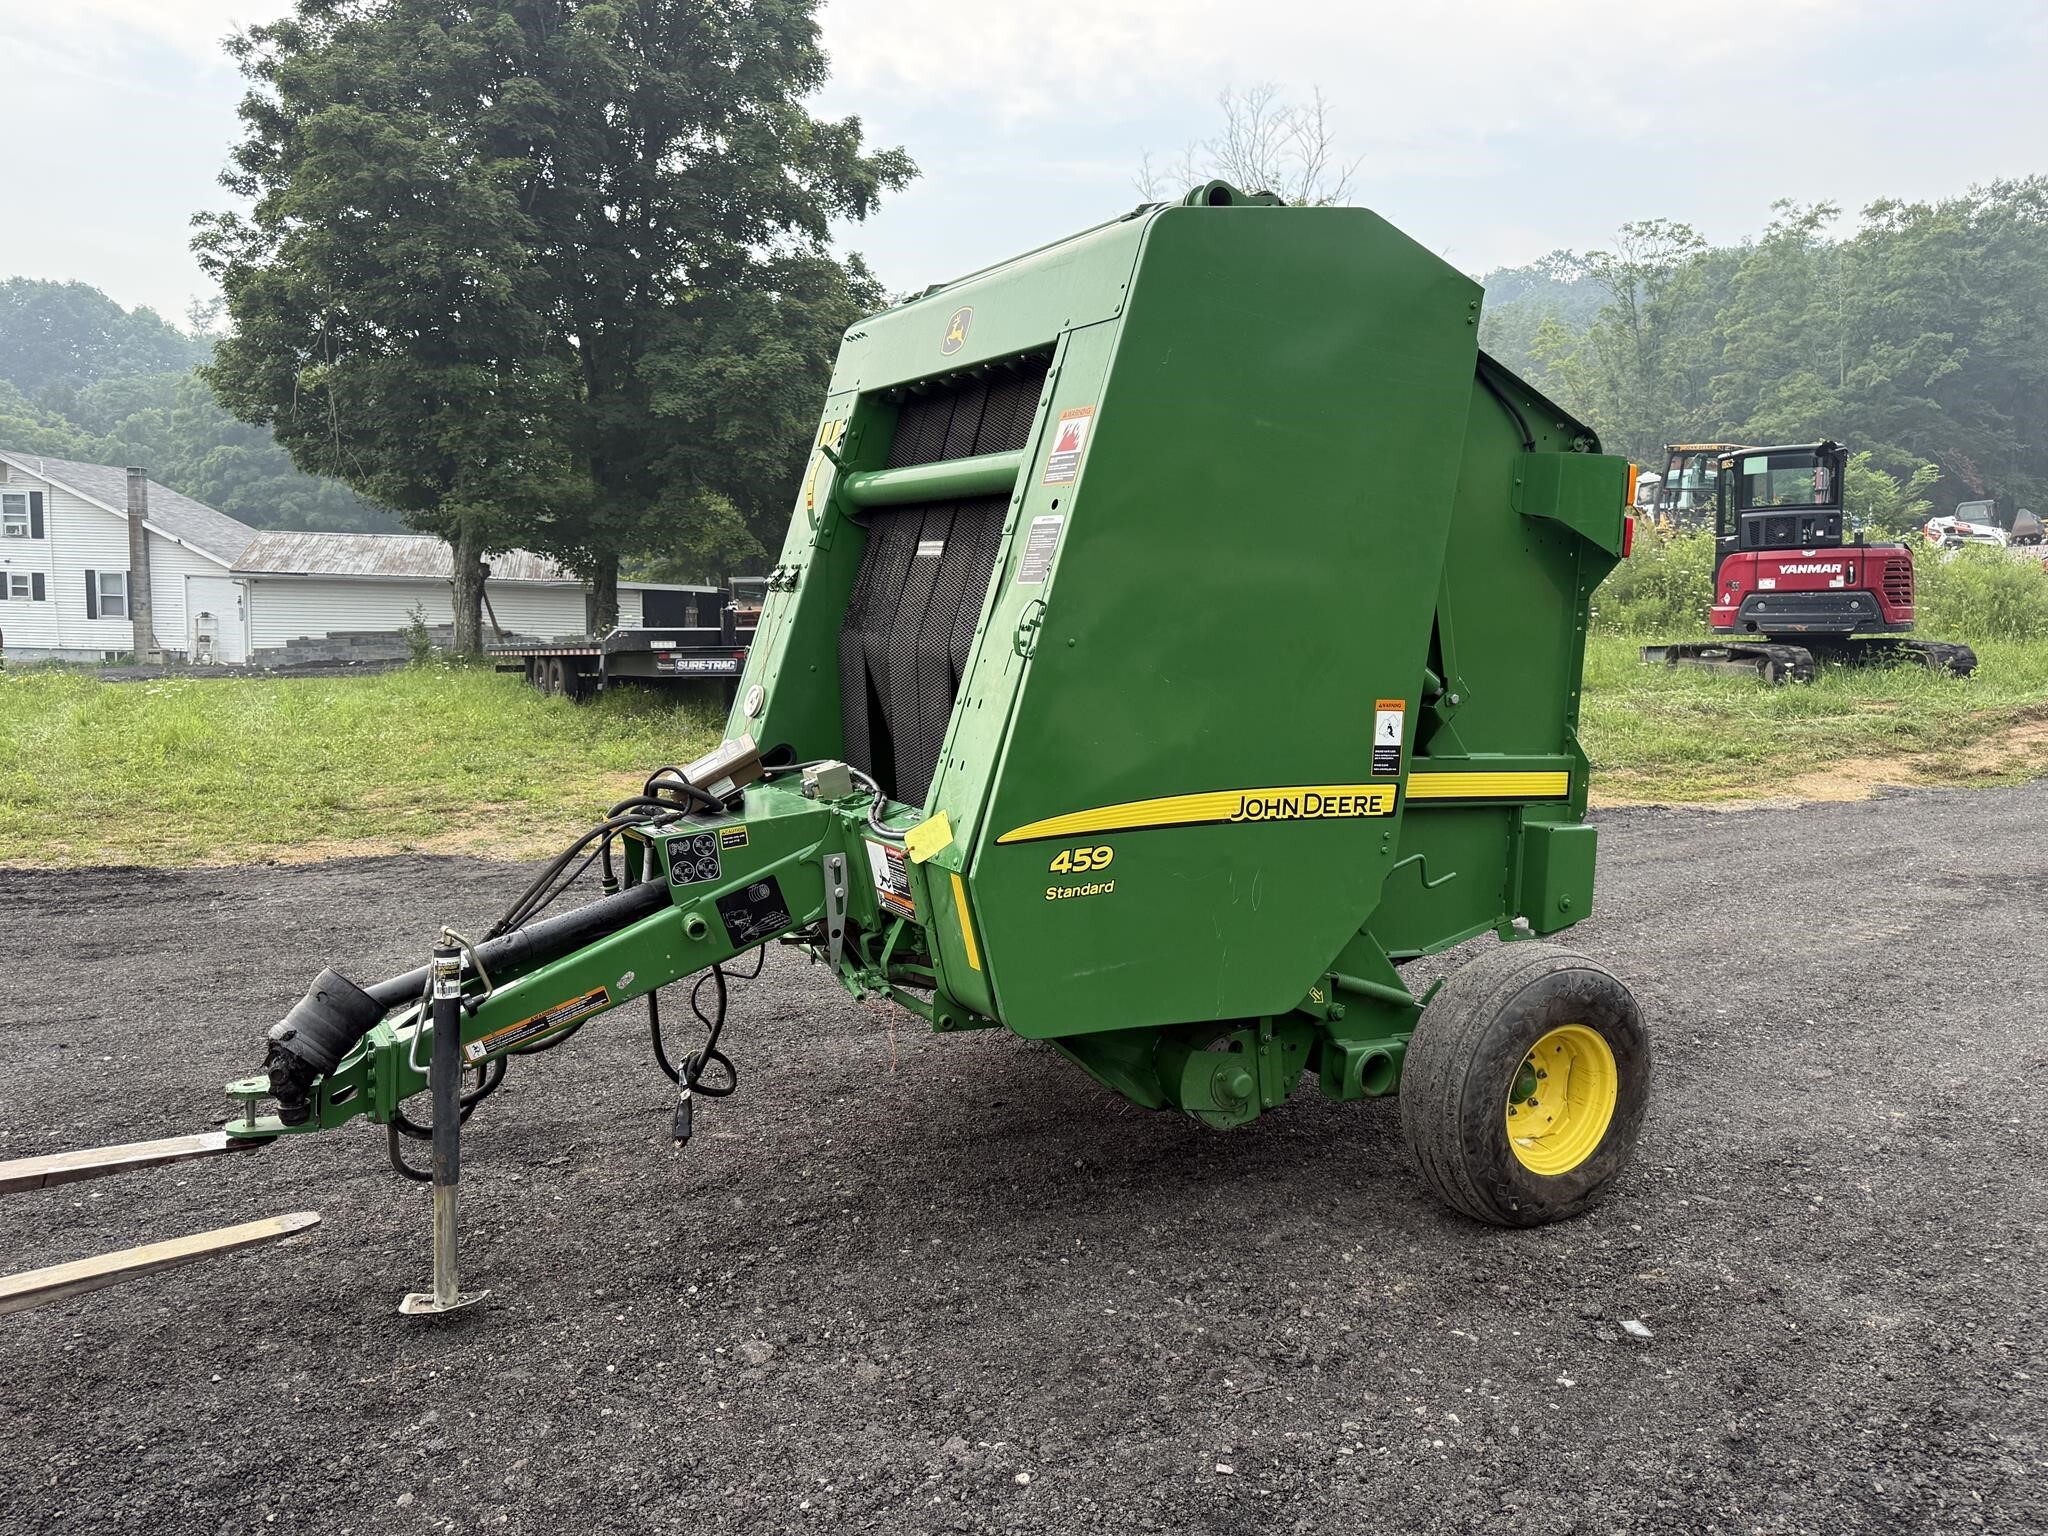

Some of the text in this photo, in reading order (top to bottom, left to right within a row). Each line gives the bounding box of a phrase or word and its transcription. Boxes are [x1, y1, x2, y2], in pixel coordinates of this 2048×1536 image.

[1778, 563, 1842, 574] YANMAR
[676, 660, 736, 671] SURE-TRAC
[1230, 792, 1384, 822] JOHN DEERE
[1049, 845, 1114, 875] 459
[1044, 878, 1116, 902] Standard
